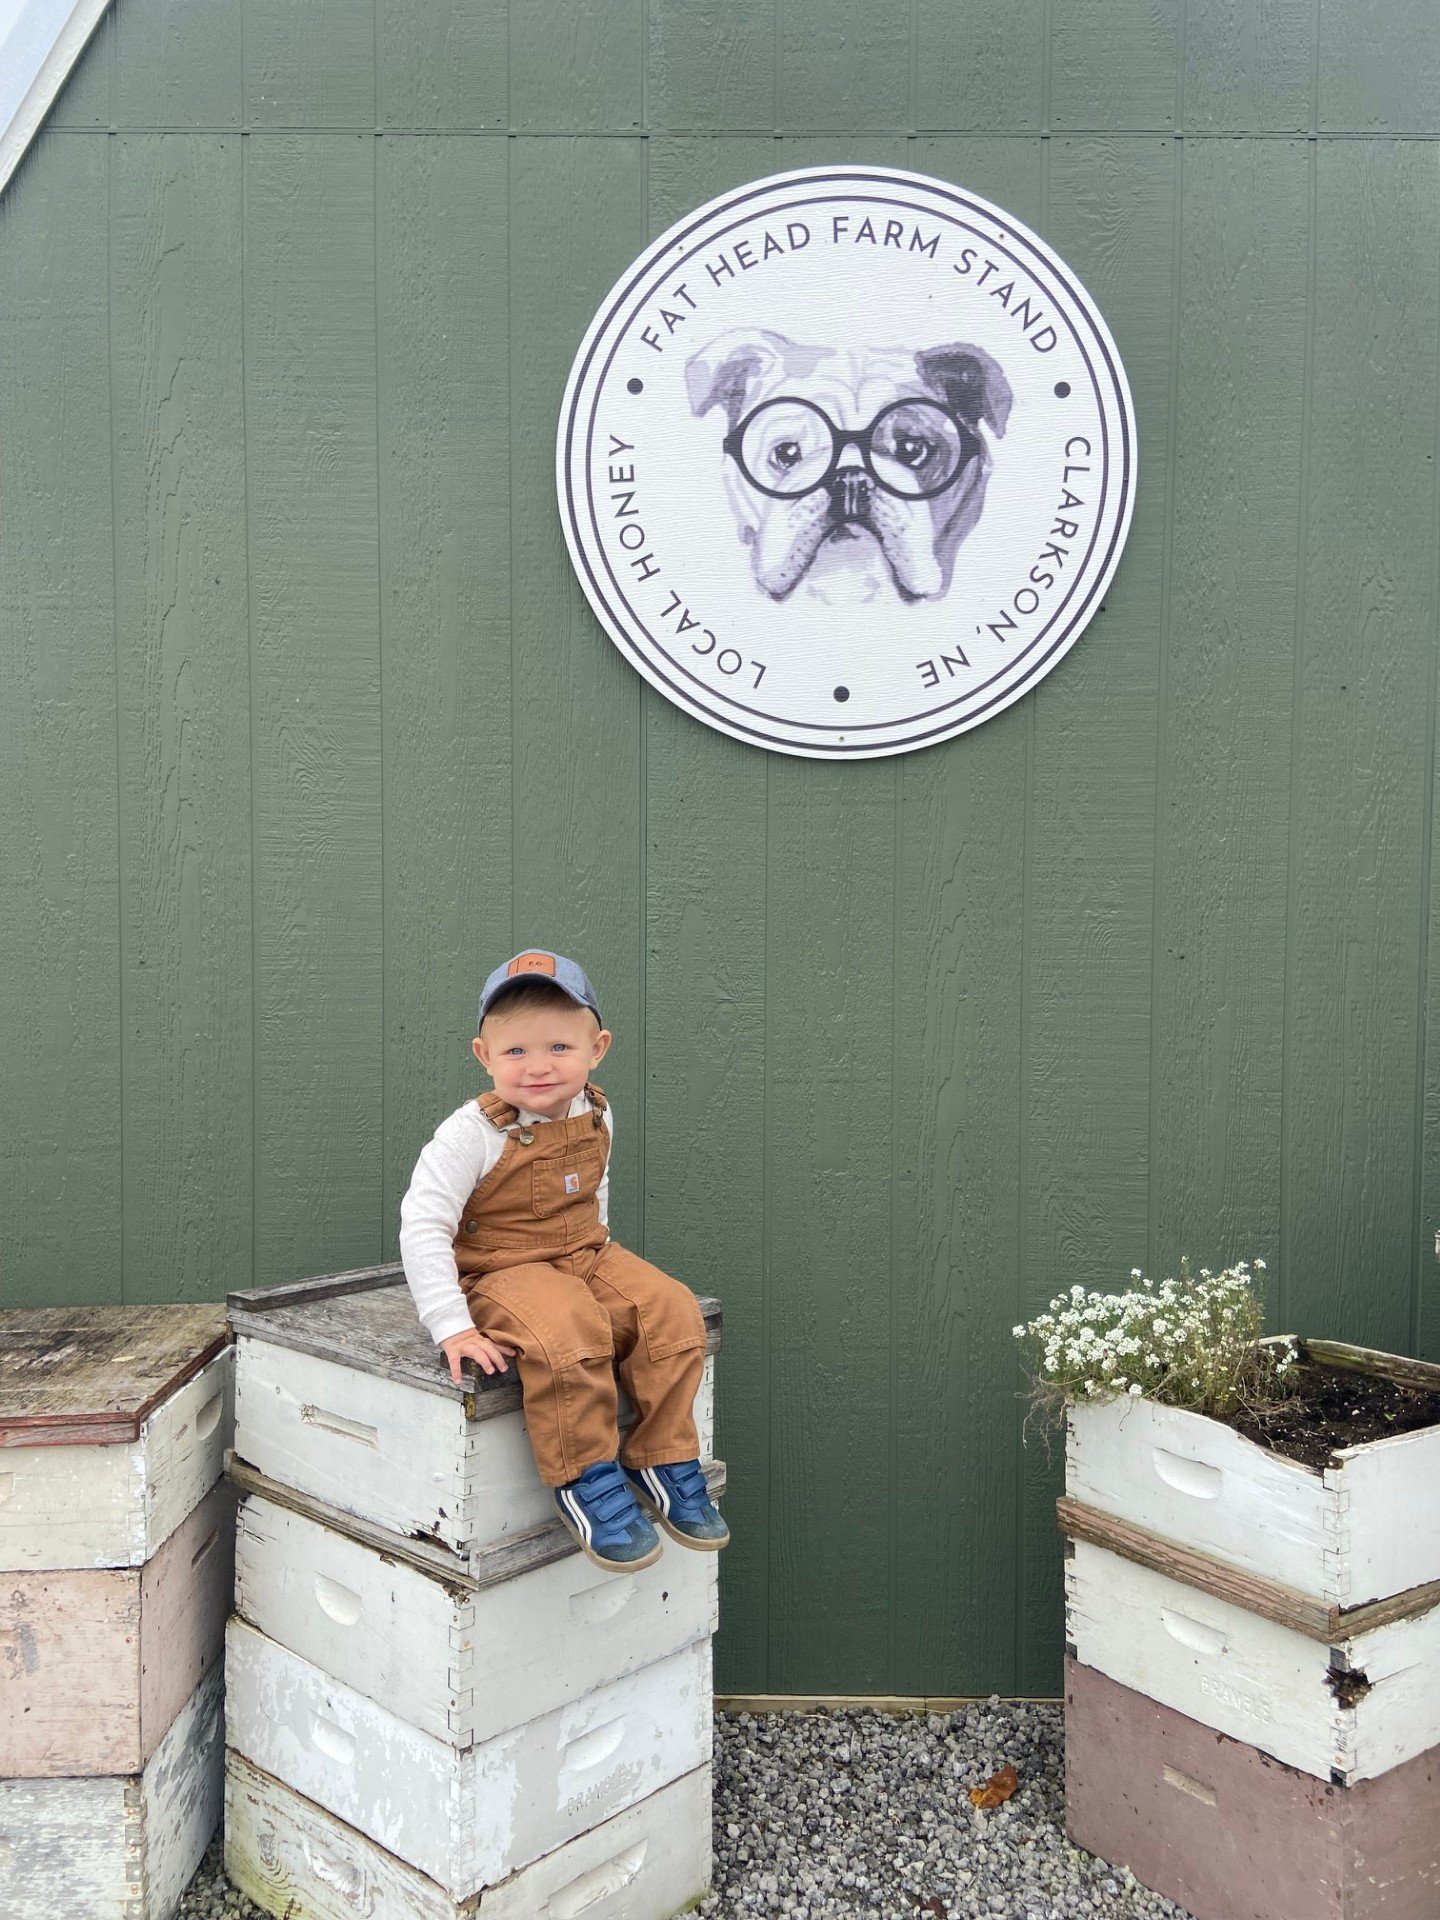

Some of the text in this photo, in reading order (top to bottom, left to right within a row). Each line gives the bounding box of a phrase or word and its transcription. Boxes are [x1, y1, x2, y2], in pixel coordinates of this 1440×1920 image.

[640, 217, 1058, 354] FAT HEAD FARM STAND
[608, 434, 767, 689] LOCAL HONEY
[916, 436, 1092, 689] CLARKSON, NE
